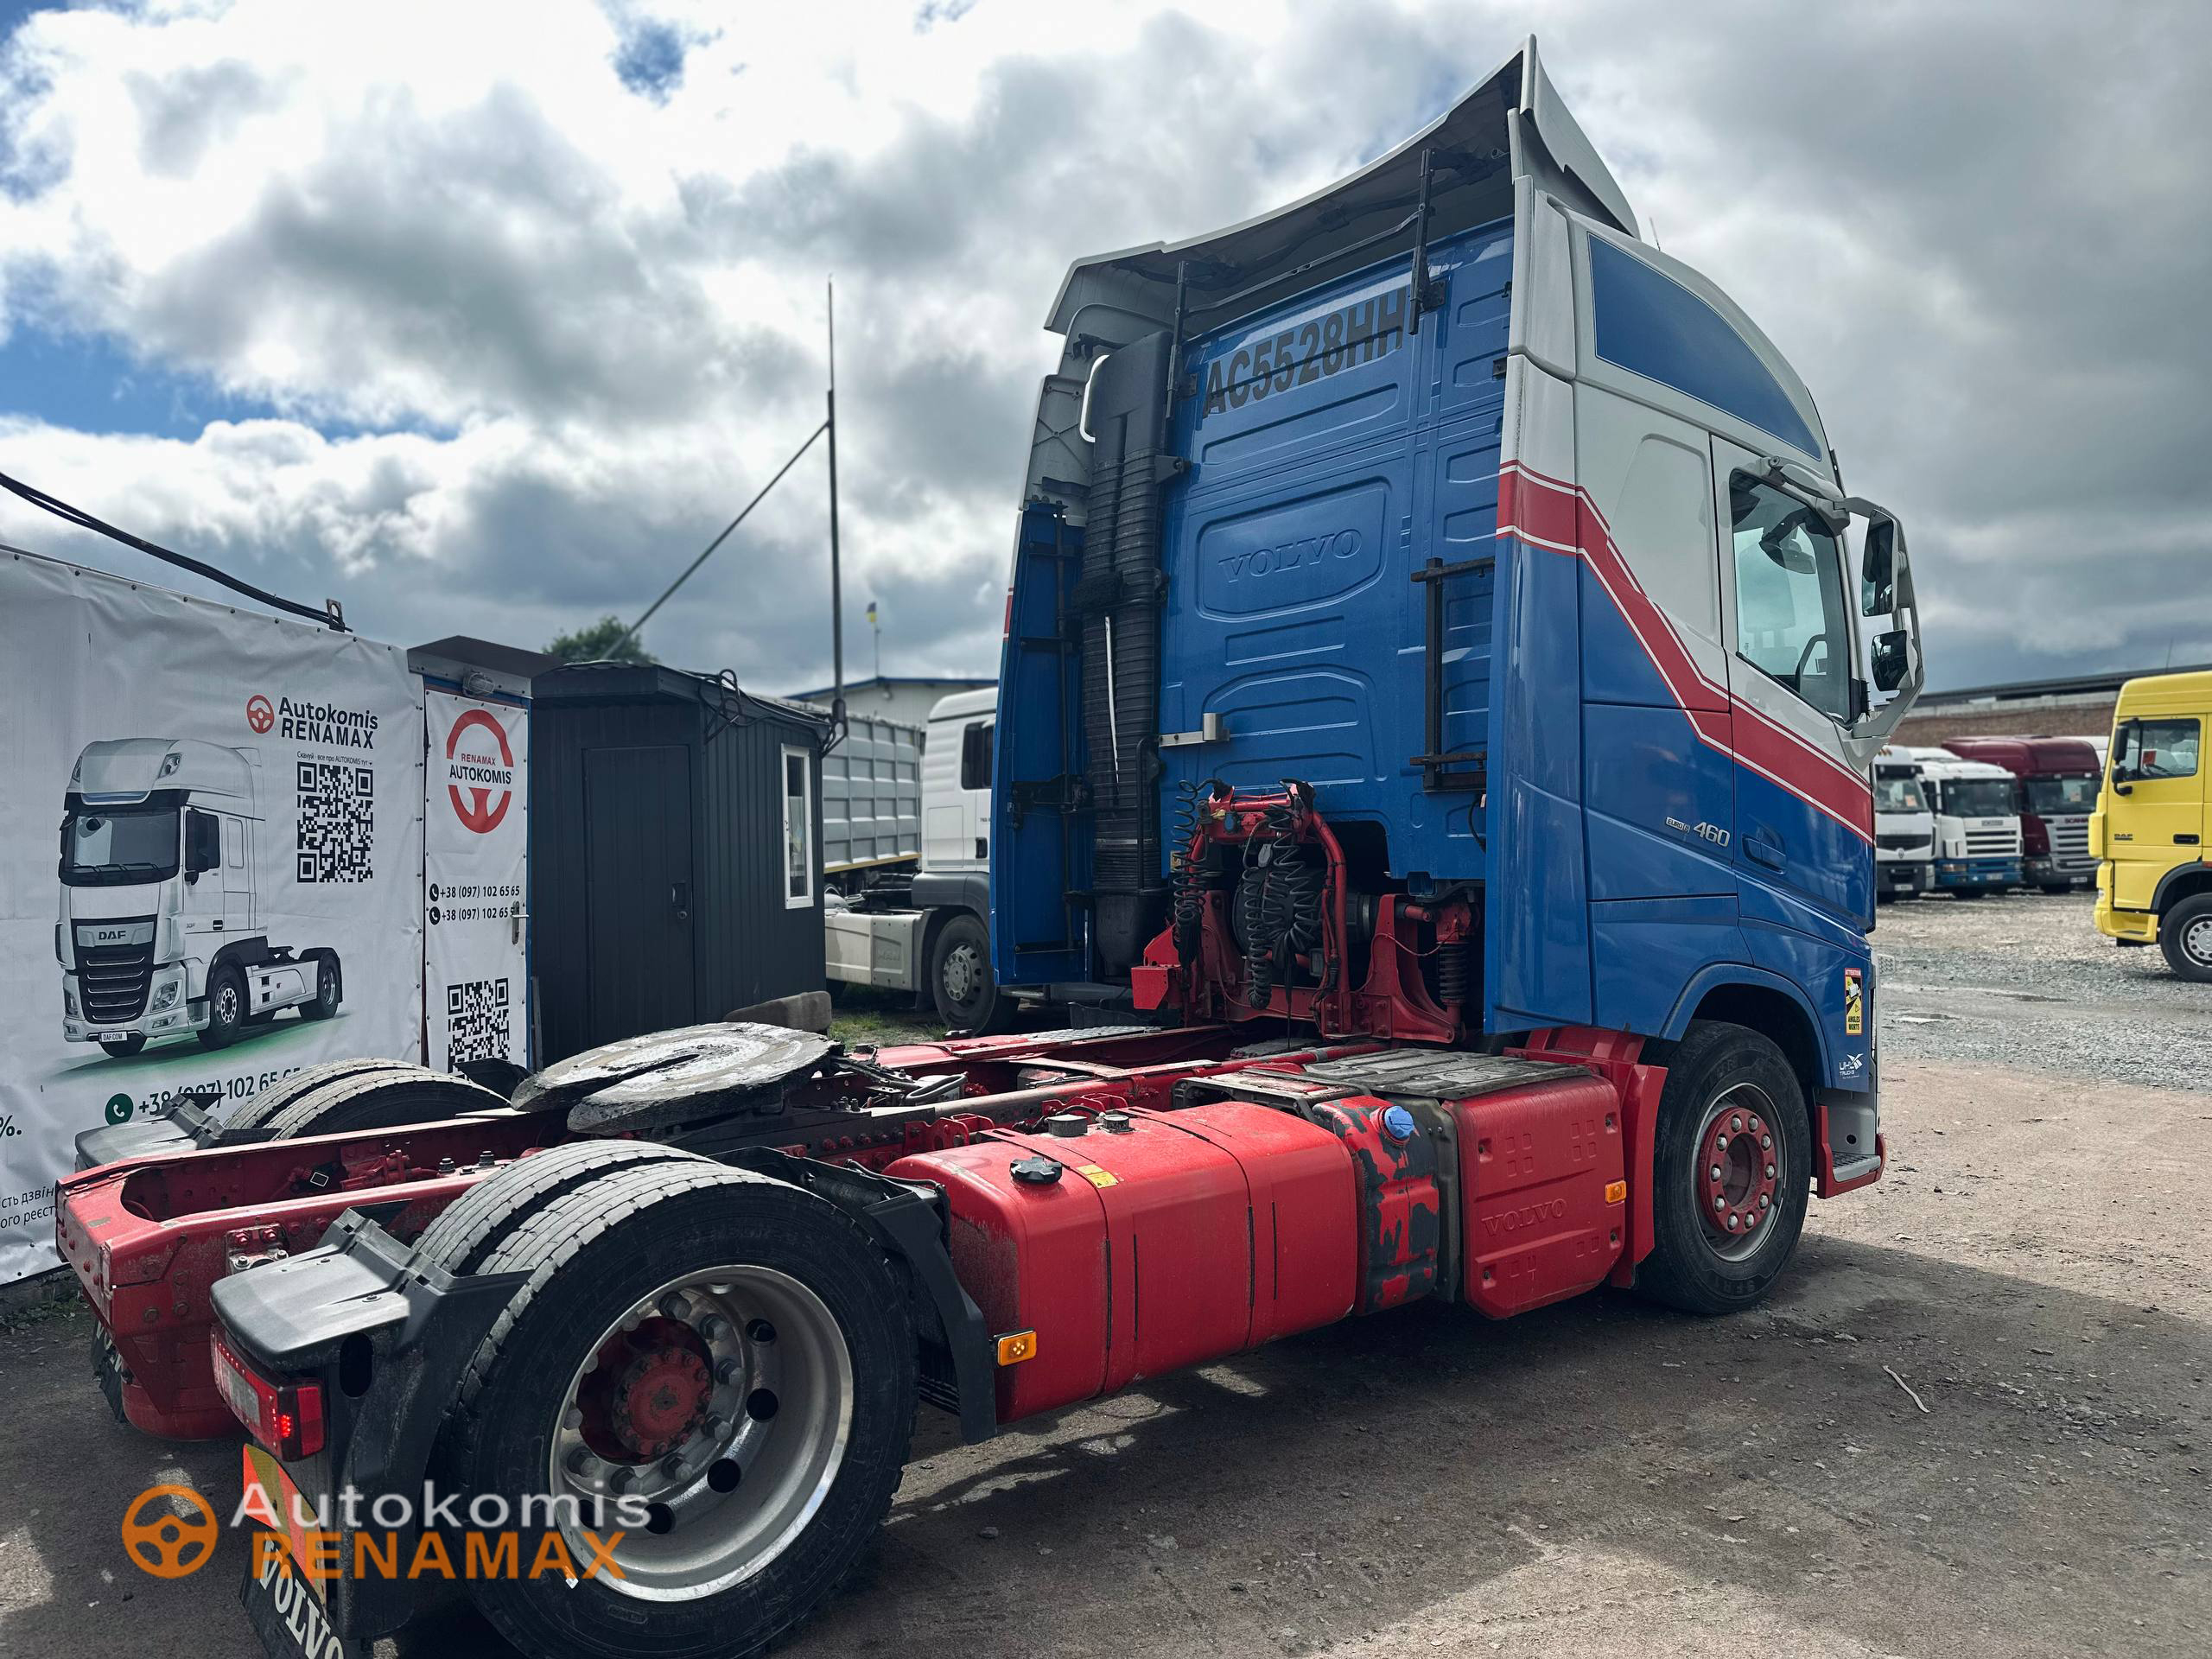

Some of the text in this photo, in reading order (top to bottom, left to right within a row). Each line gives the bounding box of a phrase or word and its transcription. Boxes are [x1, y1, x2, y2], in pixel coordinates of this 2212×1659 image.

[1202, 286, 1407, 418] AC5528HH
[1217, 529, 1363, 583] VOLVO
[278, 696, 378, 730] Autokomis
[281, 717, 374, 749] RENAMAX
[461, 753, 496, 766] RENAMAX
[449, 764, 512, 785] AUTOKOMIS
[1693, 822, 1731, 847] 460
[440, 887, 456, 898] +38
[459, 886, 480, 899] (097)
[483, 886, 497, 897] 102
[442, 909, 456, 921] +38
[459, 907, 480, 921] (097)
[482, 907, 497, 918] 102
[499, 907, 508, 918] 65
[99, 931, 126, 940] DAF
[226, 1076, 255, 1100] 102
[1481, 1198, 1567, 1237] VOLVO
